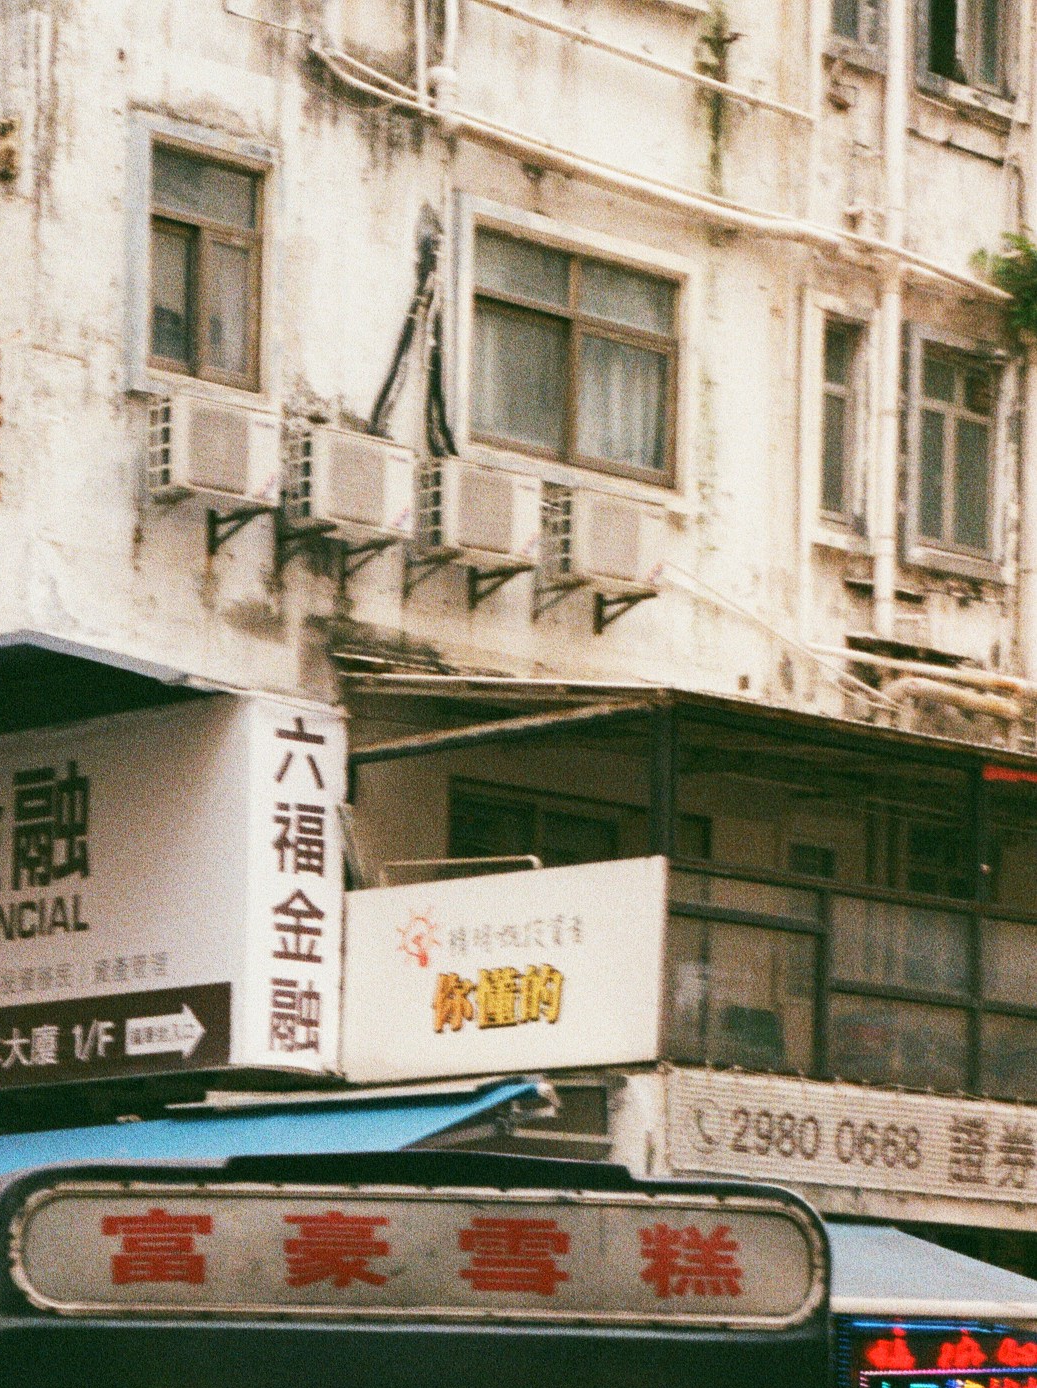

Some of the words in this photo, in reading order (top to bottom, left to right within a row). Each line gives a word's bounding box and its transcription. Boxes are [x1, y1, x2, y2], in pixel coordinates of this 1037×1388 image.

[268, 716, 326, 1054] 六福金融
[432, 963, 564, 1034] 你懂的
[71, 1019, 115, 1063] 1/F
[729, 1105, 820, 1161] 2980
[835, 1119, 923, 1170] 0668
[101, 1207, 744, 1298] 富豪雪糕
